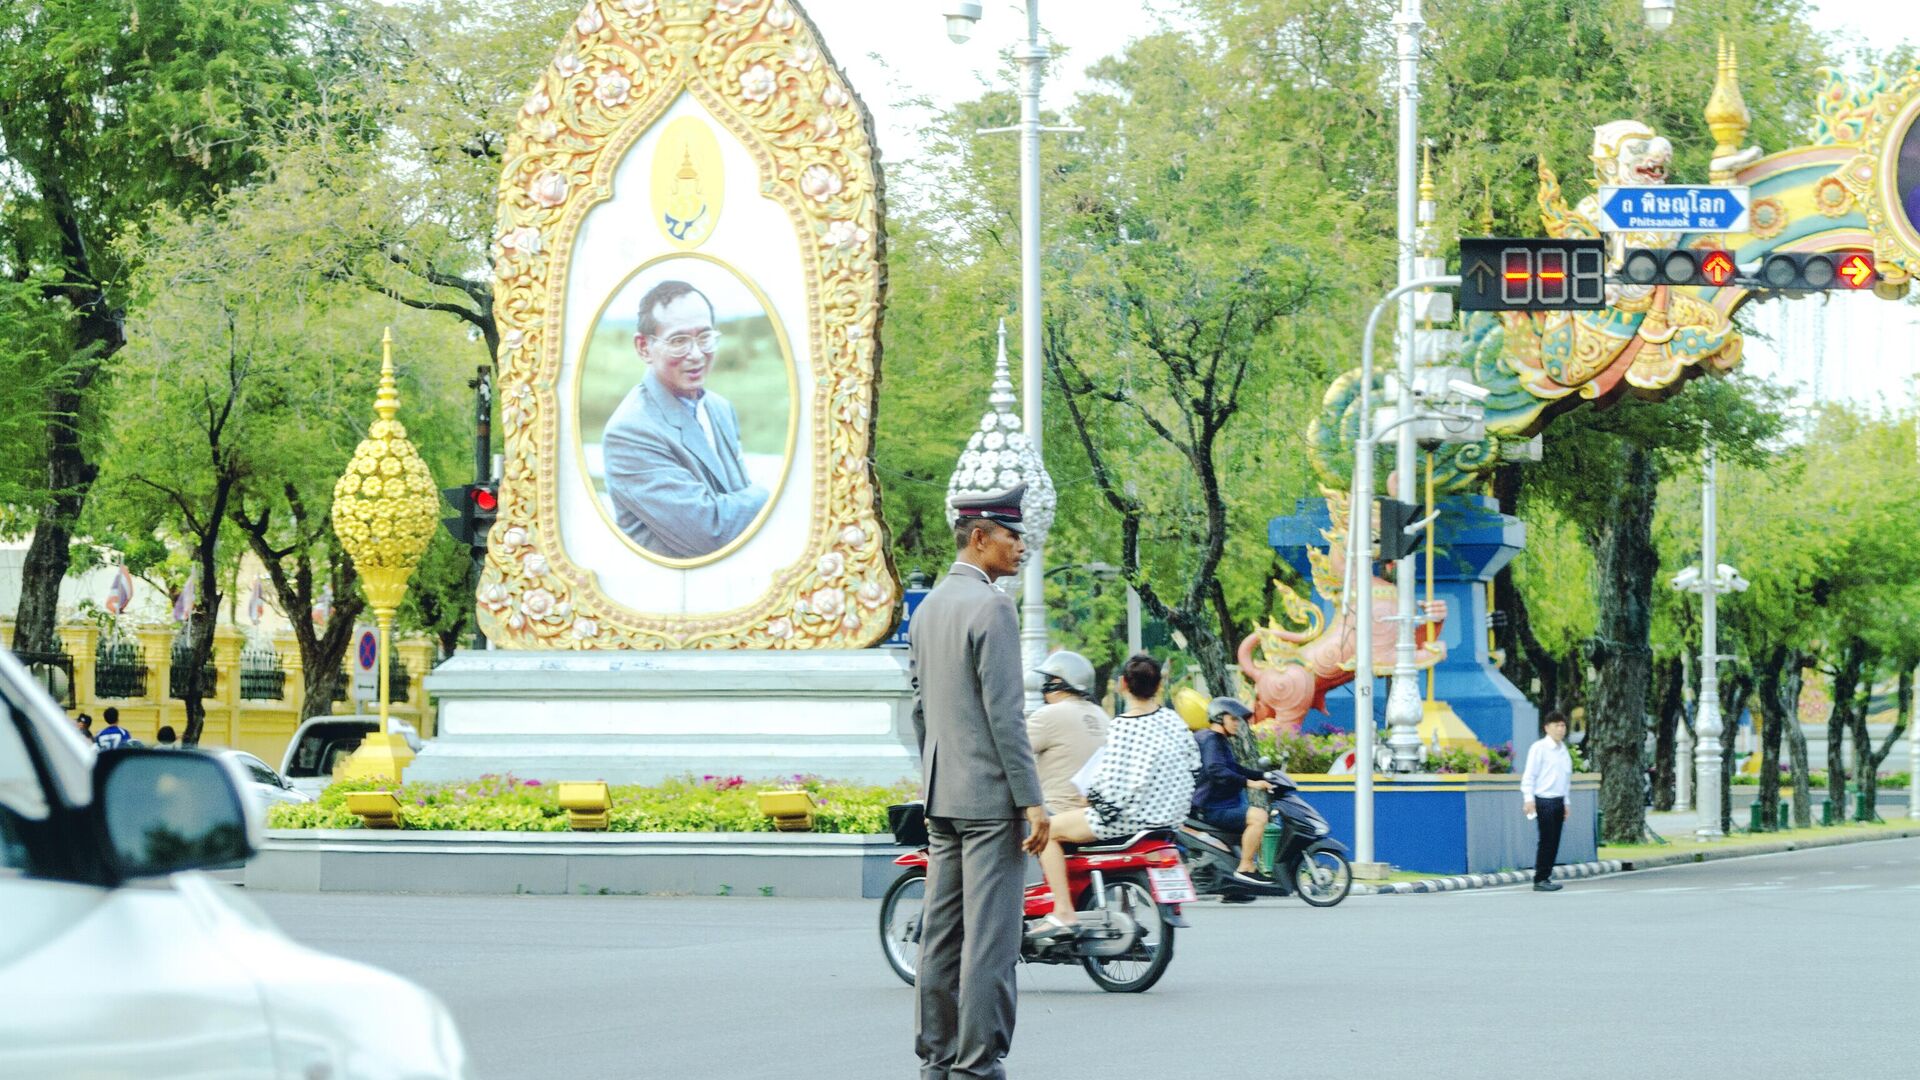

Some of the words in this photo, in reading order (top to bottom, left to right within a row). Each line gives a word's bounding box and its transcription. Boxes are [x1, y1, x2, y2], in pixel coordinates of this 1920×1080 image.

[1641, 190, 1726, 218] พิษณุโลก
[1629, 217, 1690, 227] Phitsanulok
